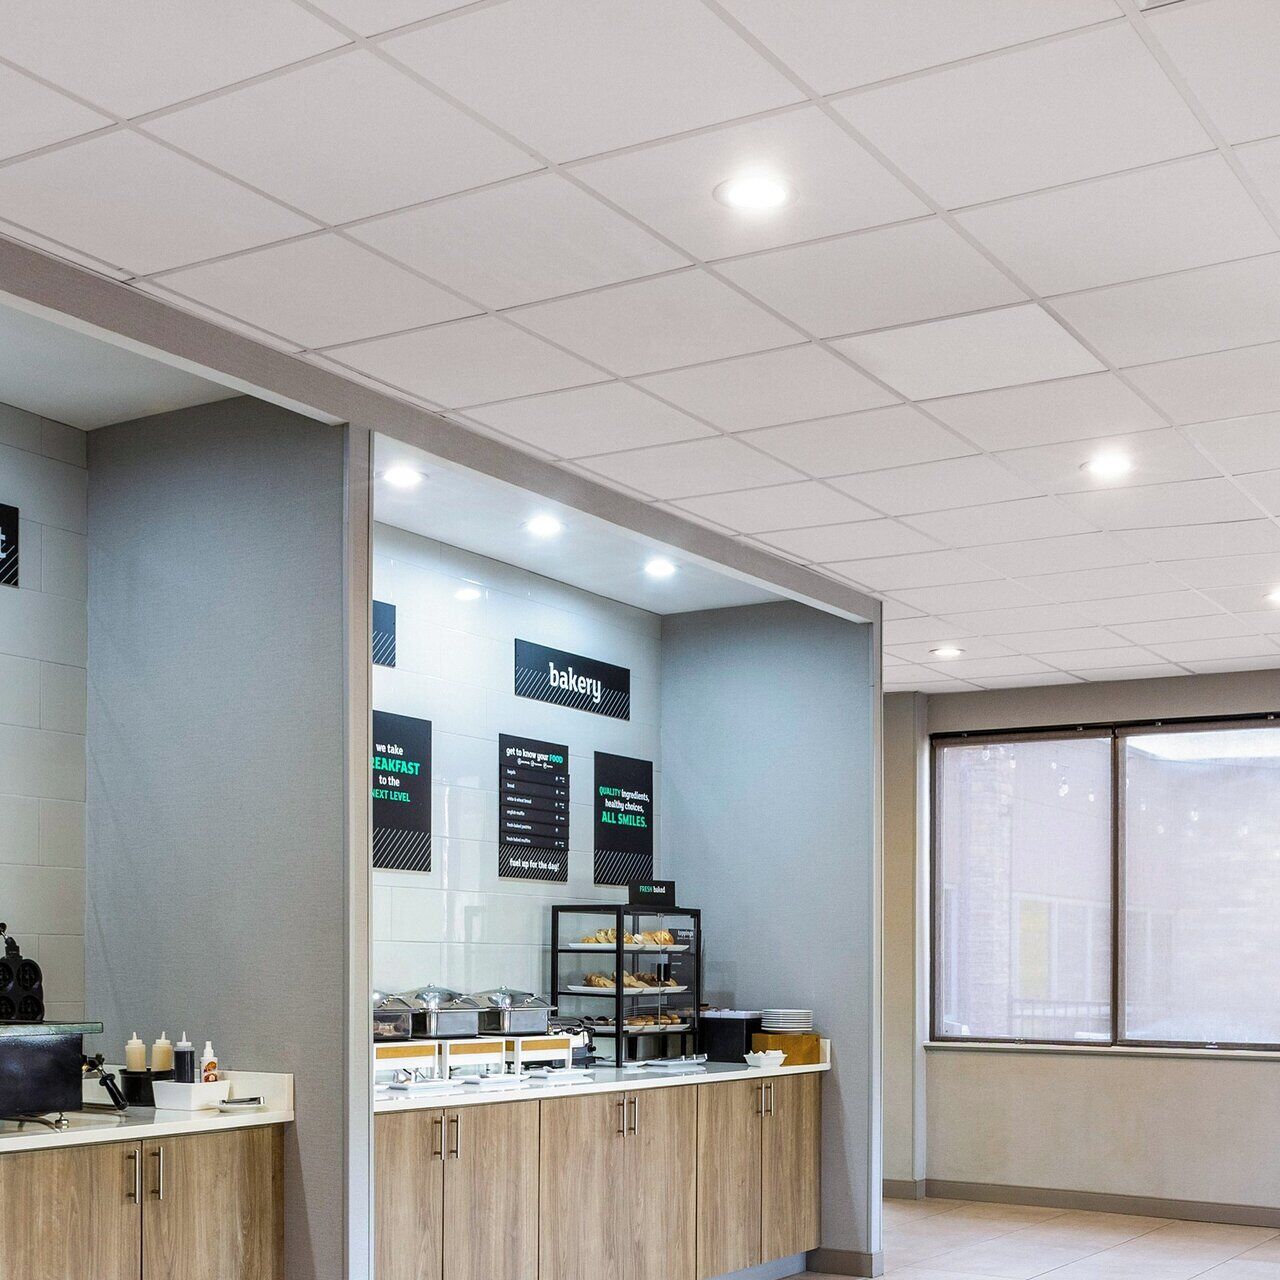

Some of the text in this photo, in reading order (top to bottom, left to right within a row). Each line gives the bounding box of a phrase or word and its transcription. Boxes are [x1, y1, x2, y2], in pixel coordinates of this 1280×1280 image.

[549, 661, 601, 703] bakery
[376, 743, 403, 755] we take
[506, 747, 515, 757] get
[549, 754, 563, 764] FOOD
[379, 775, 400, 787] to the
[390, 790, 410, 802] LEVEL
[599, 786, 620, 796] QUALITY
[605, 798, 624, 811] healthy
[602, 811, 647, 828] ALL SMILES.
